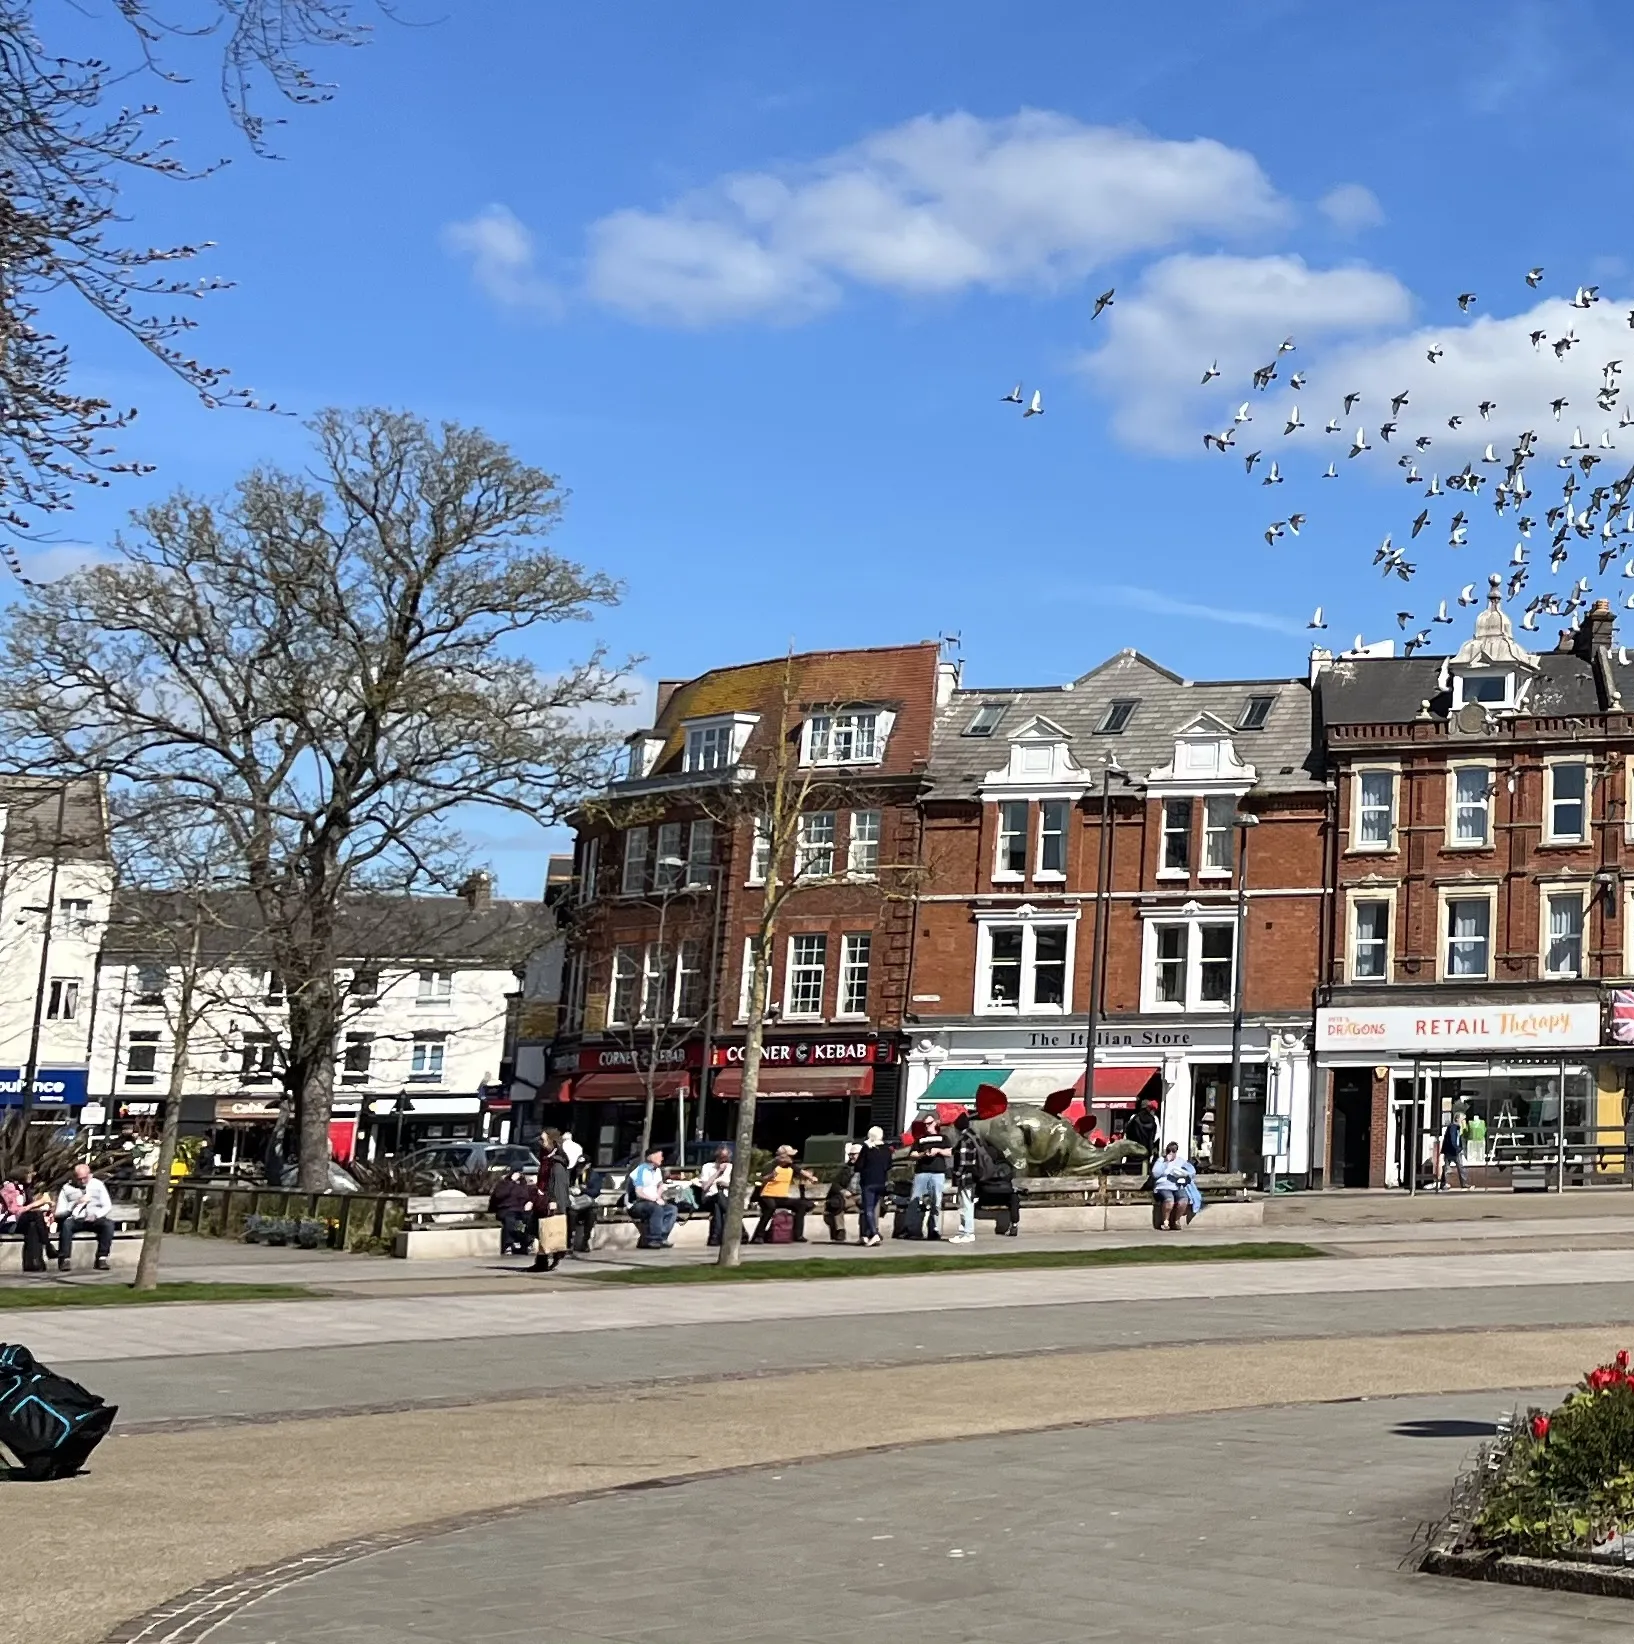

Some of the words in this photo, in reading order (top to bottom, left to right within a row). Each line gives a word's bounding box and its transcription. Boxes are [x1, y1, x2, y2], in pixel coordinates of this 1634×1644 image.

[1328, 1024, 1386, 1035] DRAGONS
[1416, 1018, 1490, 1035] RETAIL
[1494, 1012, 1573, 1037] Therapy
[1029, 1032, 1060, 1046] The
[1069, 1031, 1132, 1046] Itlian
[1141, 1031, 1191, 1045] Store
[598, 1051, 637, 1066] CORNE
[726, 1046, 790, 1062] CONER
[814, 1043, 868, 1060] KEBAB
